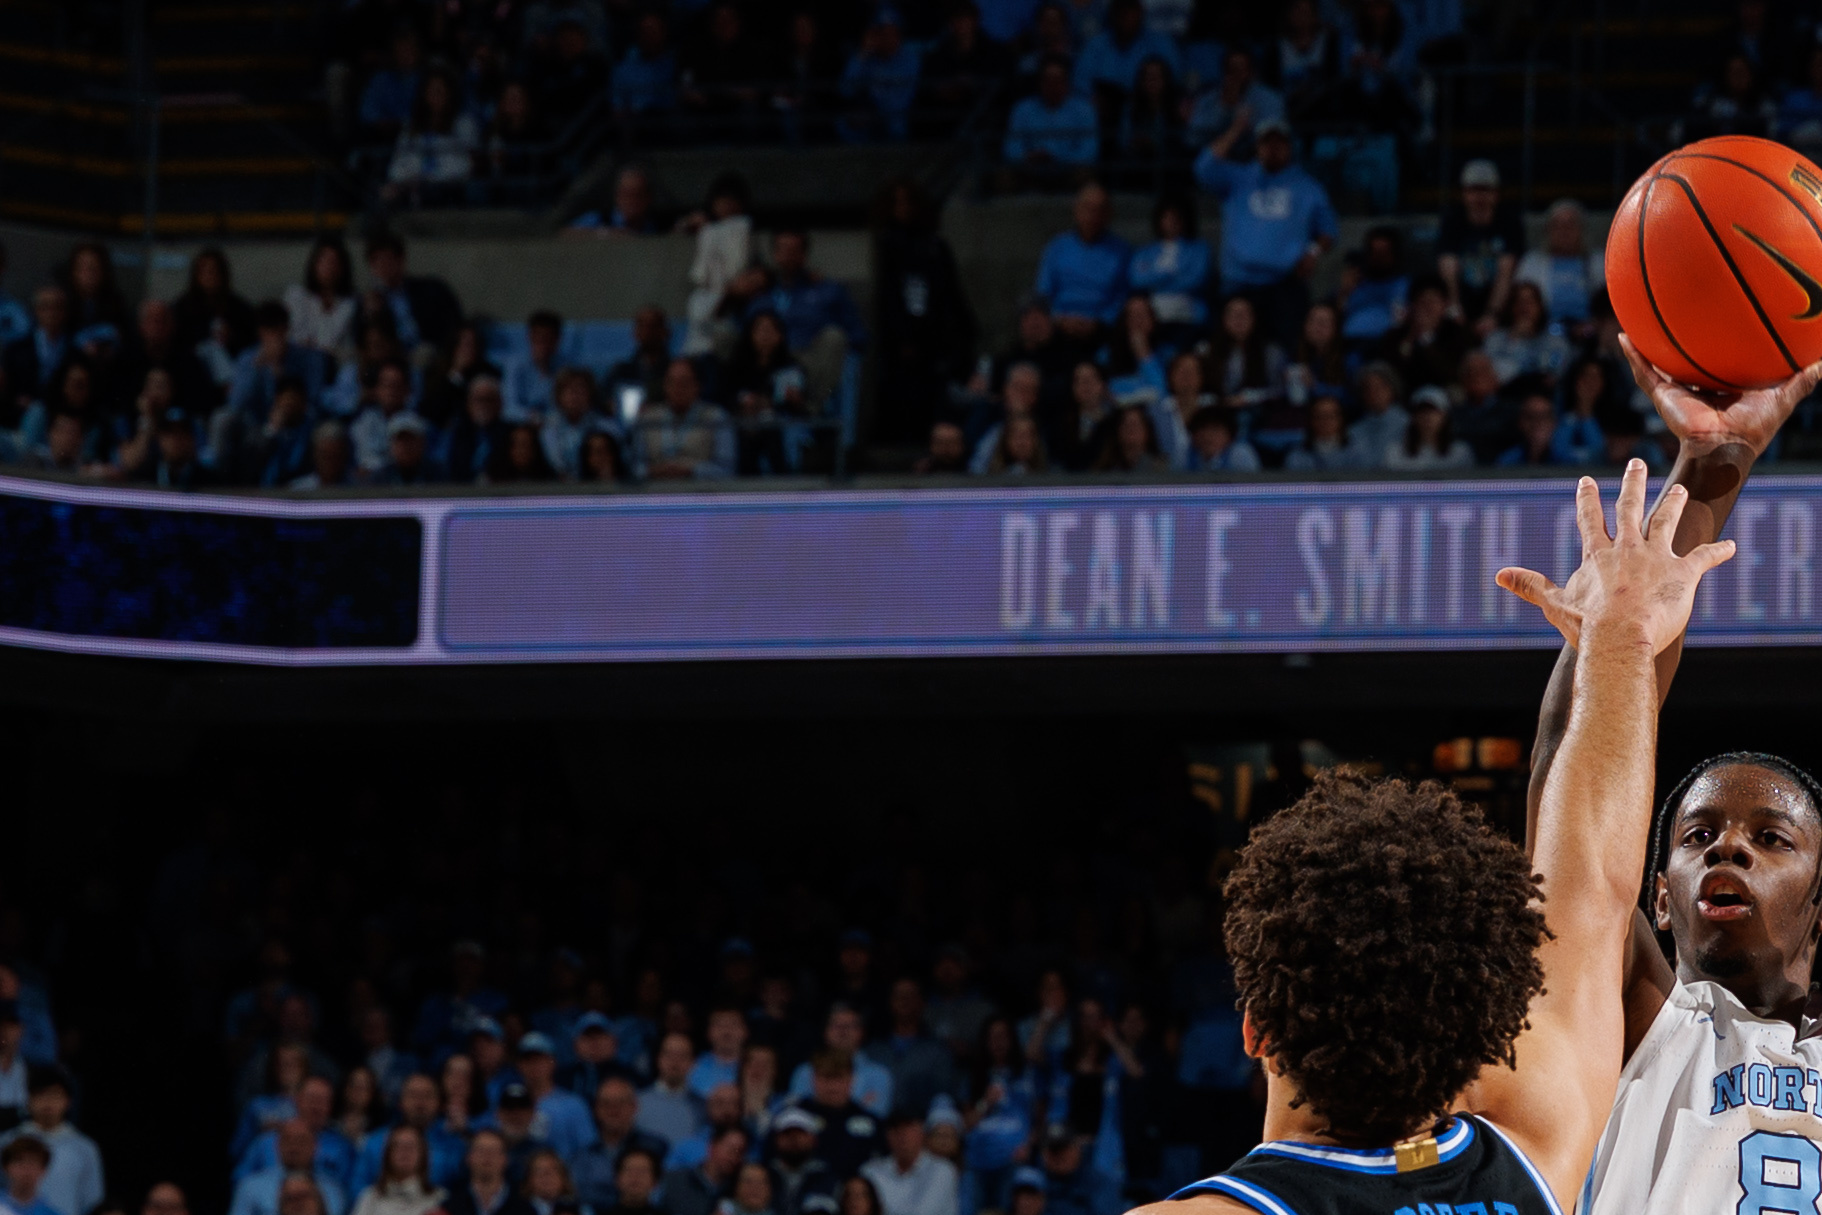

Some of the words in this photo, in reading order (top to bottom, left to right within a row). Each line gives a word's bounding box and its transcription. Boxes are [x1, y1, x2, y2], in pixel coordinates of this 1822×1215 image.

[1003, 511, 1174, 628] DEAN
[1205, 509, 1262, 627] E.
[1295, 504, 1522, 627] SMITH
